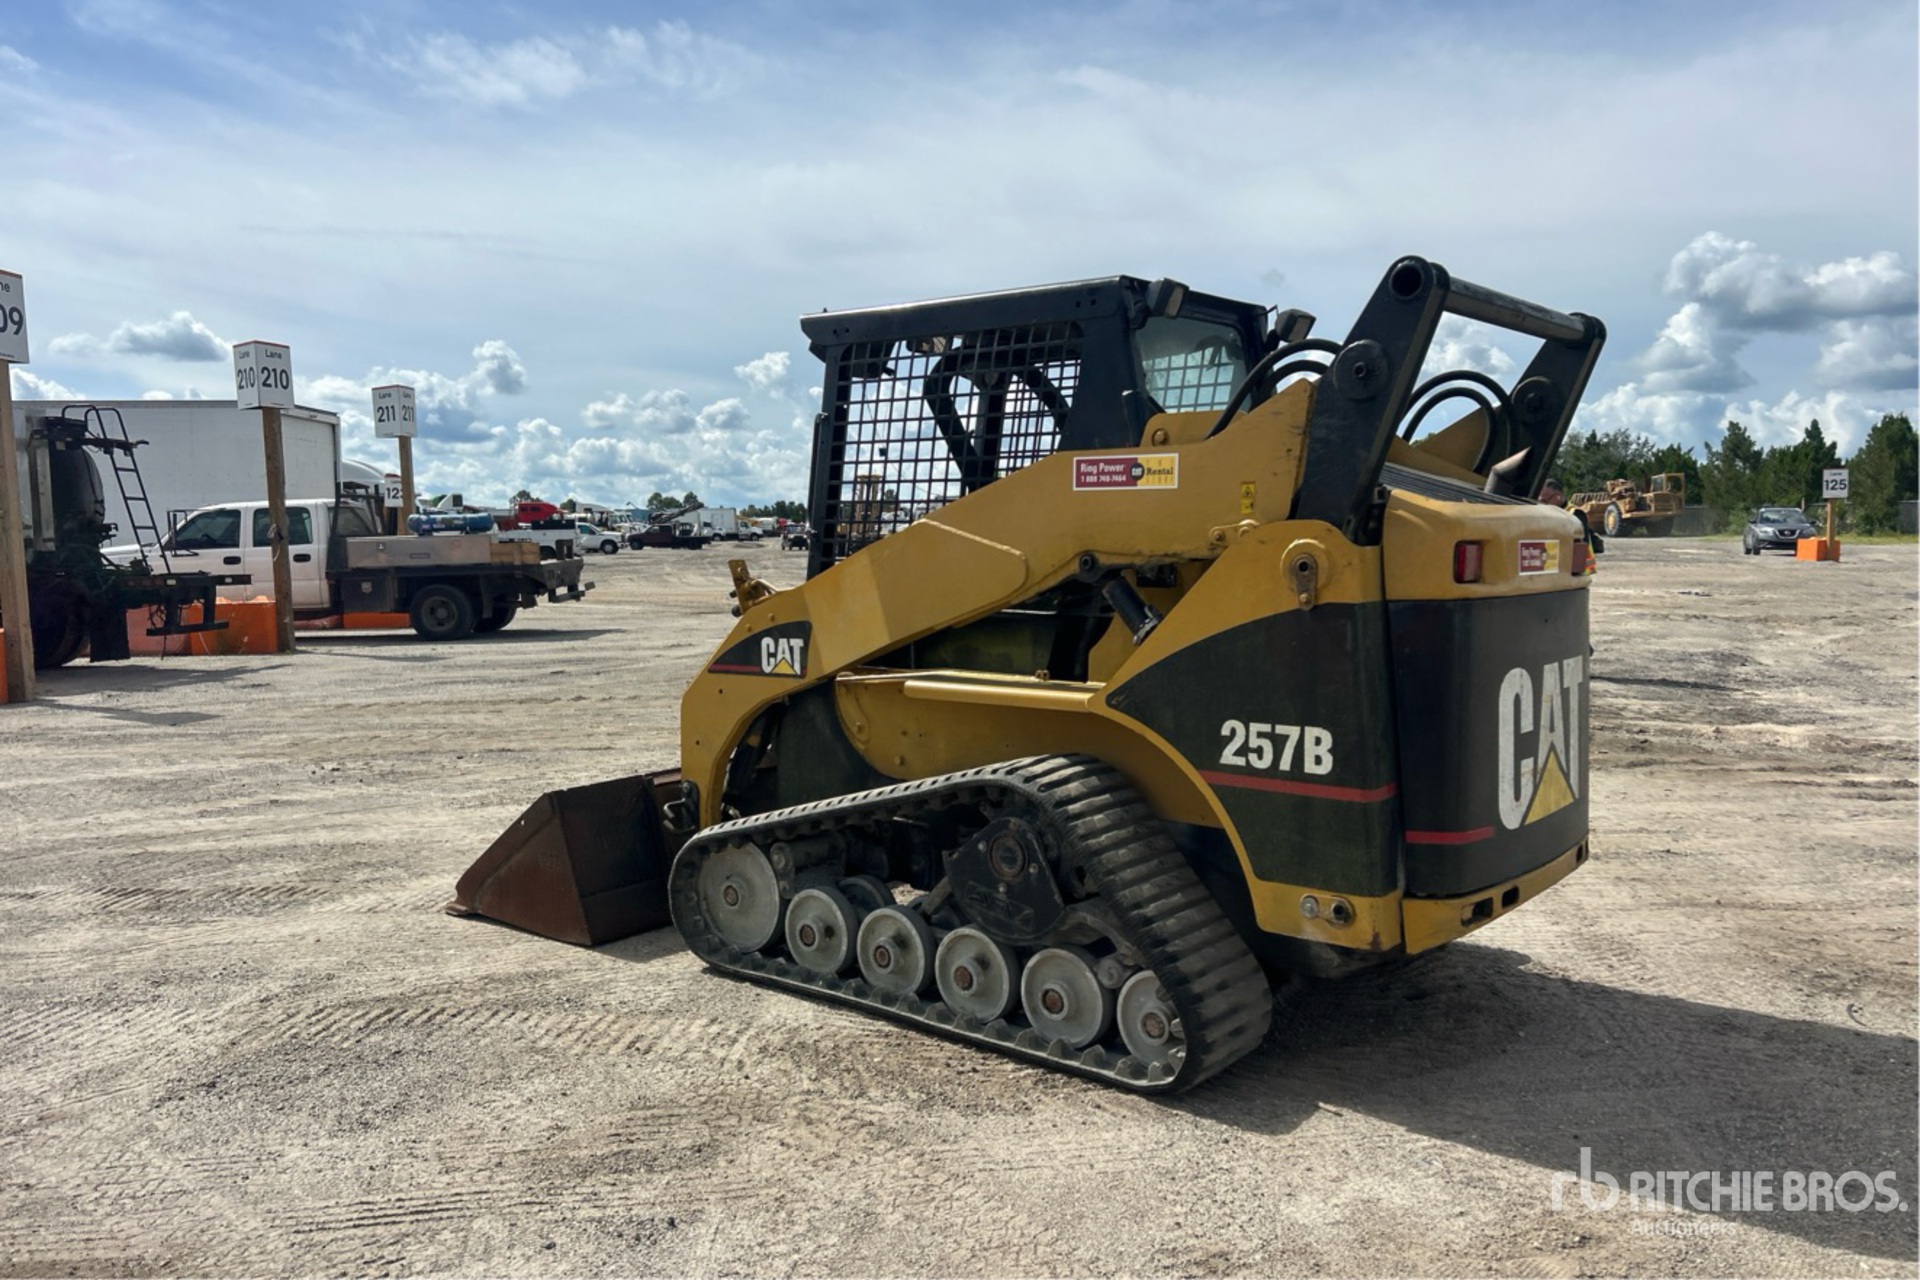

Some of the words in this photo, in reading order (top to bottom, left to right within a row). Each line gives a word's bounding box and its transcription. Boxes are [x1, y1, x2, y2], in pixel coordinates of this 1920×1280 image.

[0, 304, 24, 336] 09
[265, 349, 282, 360] Lane
[237, 366, 256, 390] 210
[261, 366, 290, 390] 210
[378, 392, 392, 400] Lane
[377, 405, 396, 423] 211
[402, 404, 415, 422] 211
[1080, 463, 1097, 474] Ring
[1099, 462, 1125, 473] Power
[1146, 467, 1174, 476] Rental
[1824, 479, 1847, 491] 125
[761, 636, 805, 676] CAT
[1219, 719, 1334, 776] 257B
[1498, 654, 1583, 830] CAT
